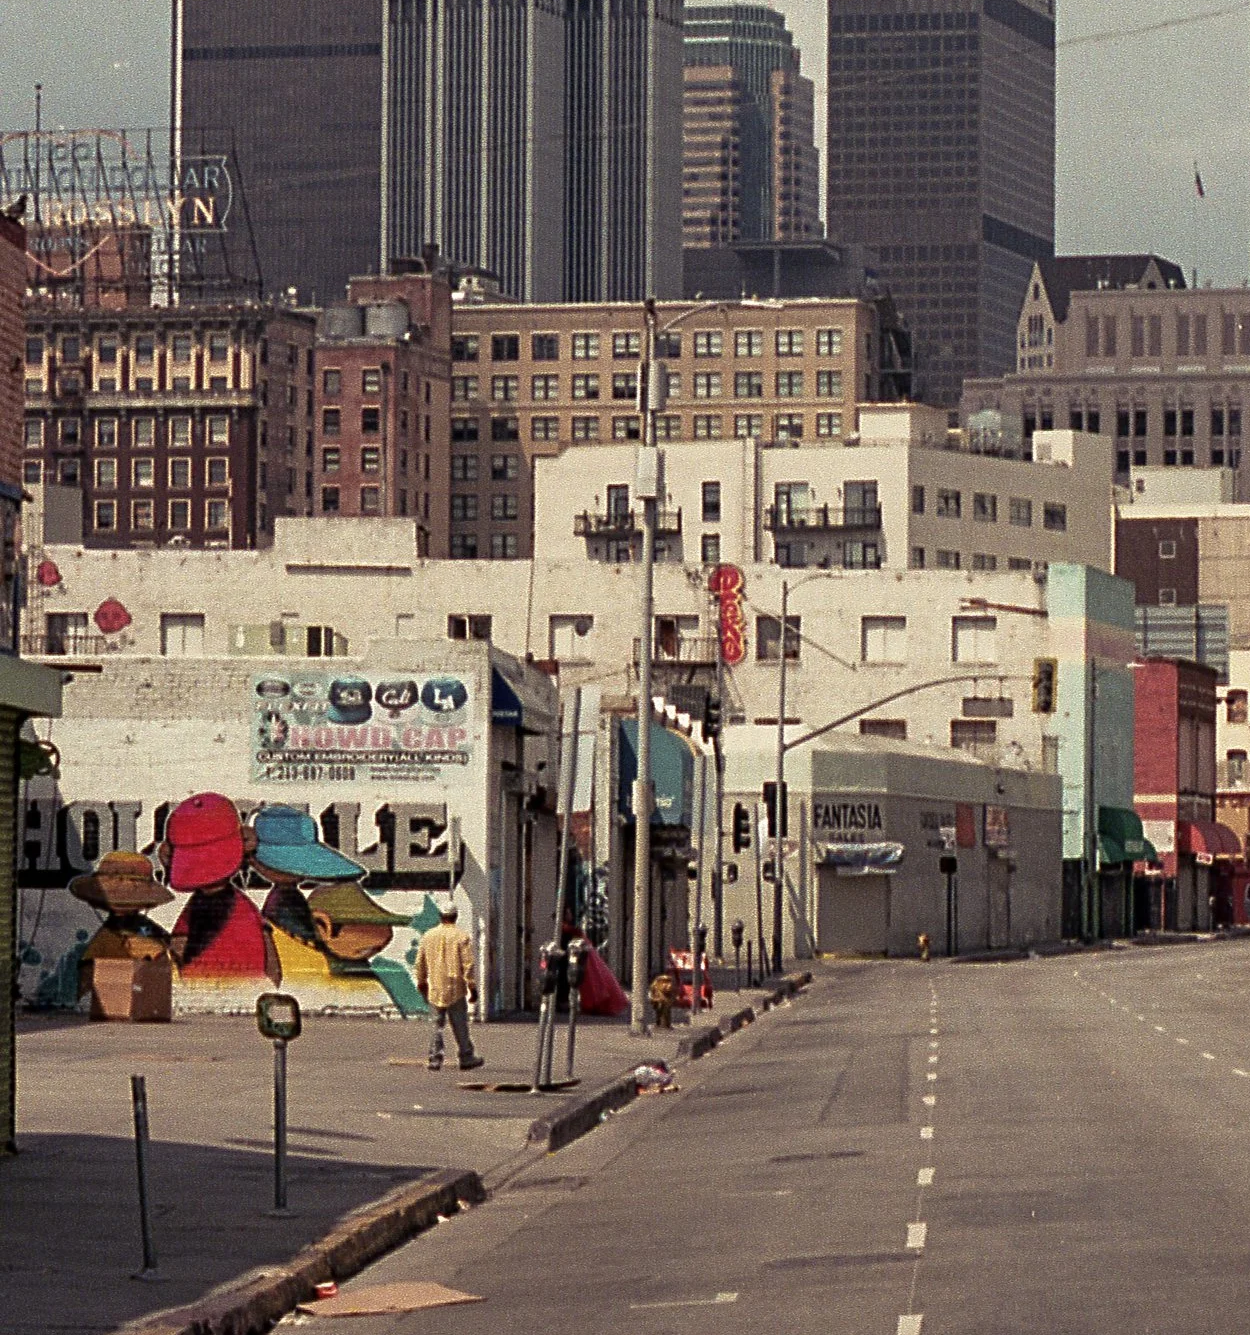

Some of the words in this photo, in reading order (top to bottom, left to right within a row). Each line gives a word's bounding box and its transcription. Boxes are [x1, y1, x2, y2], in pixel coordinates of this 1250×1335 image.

[45, 197, 215, 226] ROSSLYN
[402, 726, 467, 749] CAP
[814, 802, 882, 830] FANTASIA
